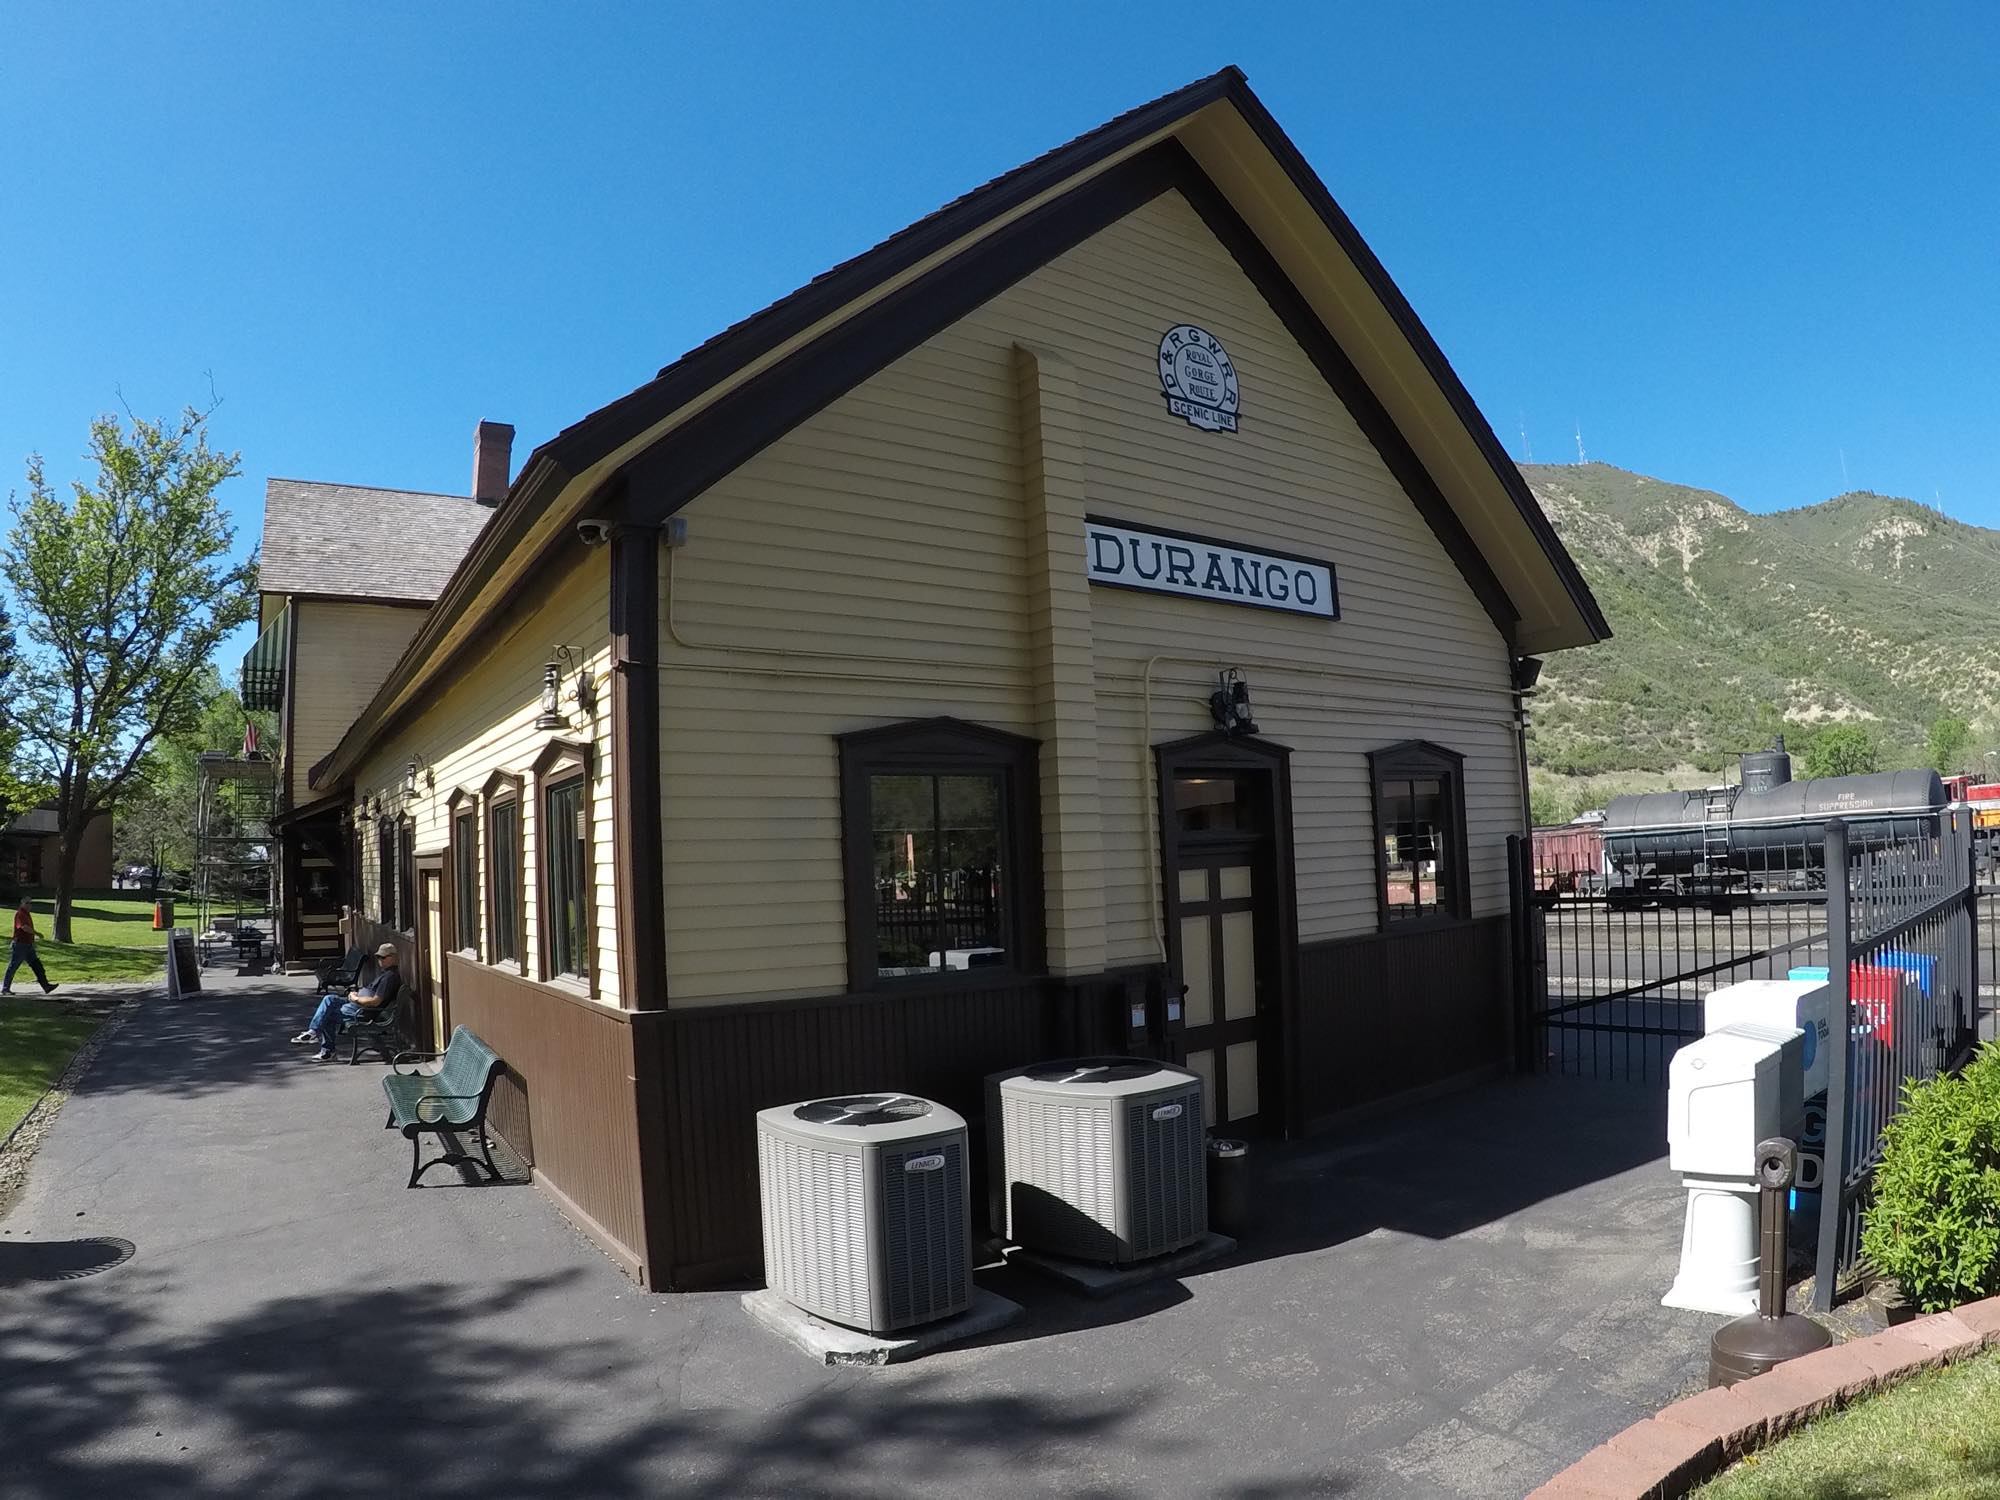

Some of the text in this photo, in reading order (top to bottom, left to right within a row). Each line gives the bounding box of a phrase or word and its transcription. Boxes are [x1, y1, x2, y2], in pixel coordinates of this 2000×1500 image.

[1184, 366, 1218, 385] GORGE
[1174, 401, 1233, 427] SCENIC LINE
[1090, 531, 1317, 605] DURANGO
[1818, 799, 1874, 812] SUPPRESSION
[1837, 792, 1856, 801] FIRE
